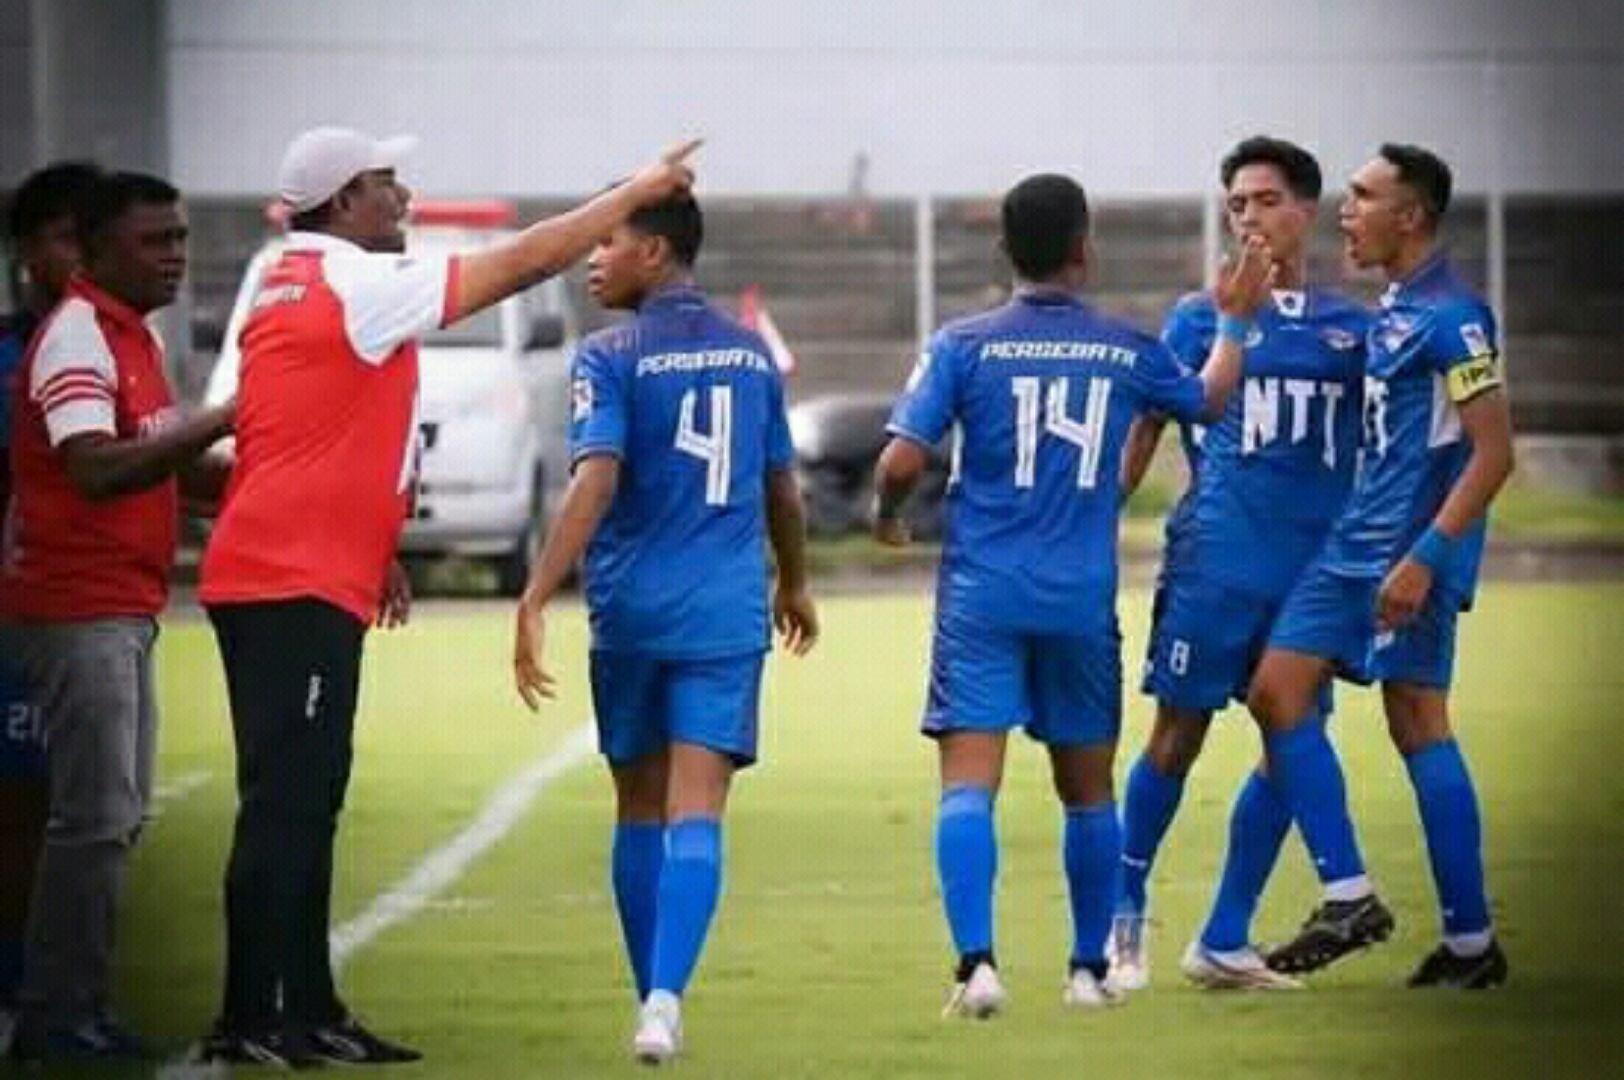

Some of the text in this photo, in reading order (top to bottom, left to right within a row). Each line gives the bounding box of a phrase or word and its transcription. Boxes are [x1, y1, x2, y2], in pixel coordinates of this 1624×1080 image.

[674, 383, 732, 506] 4
[1011, 376, 1112, 489] 14
[1241, 375, 1344, 470] NTT
[1169, 638, 1191, 677] 8
